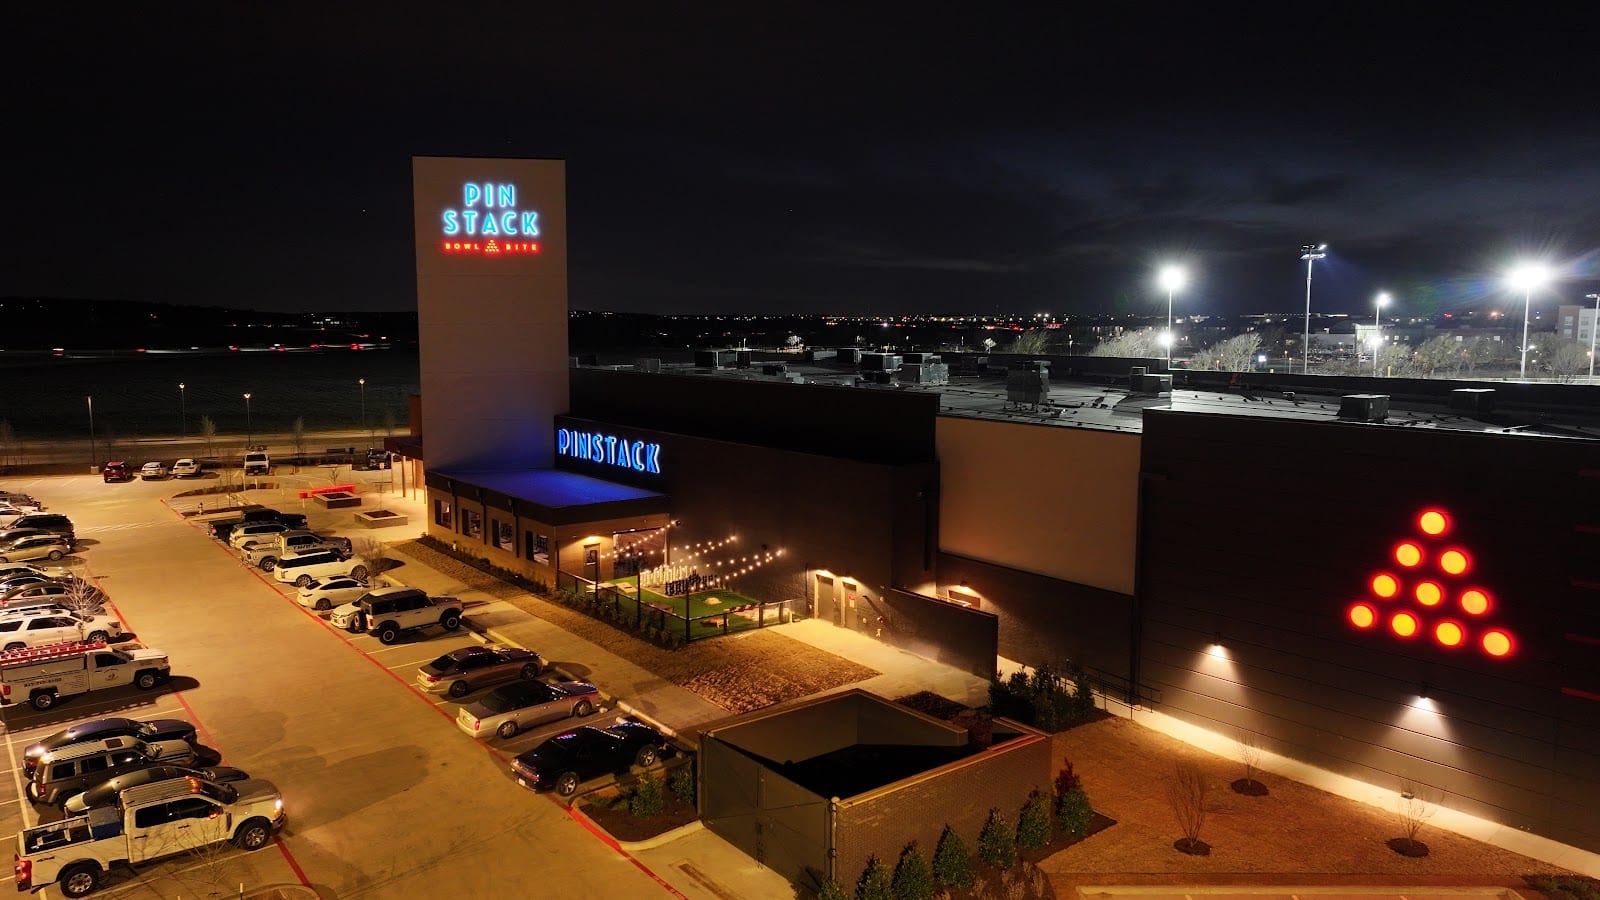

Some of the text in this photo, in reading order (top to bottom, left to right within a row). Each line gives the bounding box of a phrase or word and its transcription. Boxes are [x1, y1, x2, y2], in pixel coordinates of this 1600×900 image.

[465, 183, 515, 207] PIN
[443, 210, 539, 235] STACK
[505, 243, 537, 251] BITE
[558, 428, 661, 474] PINSTACK
